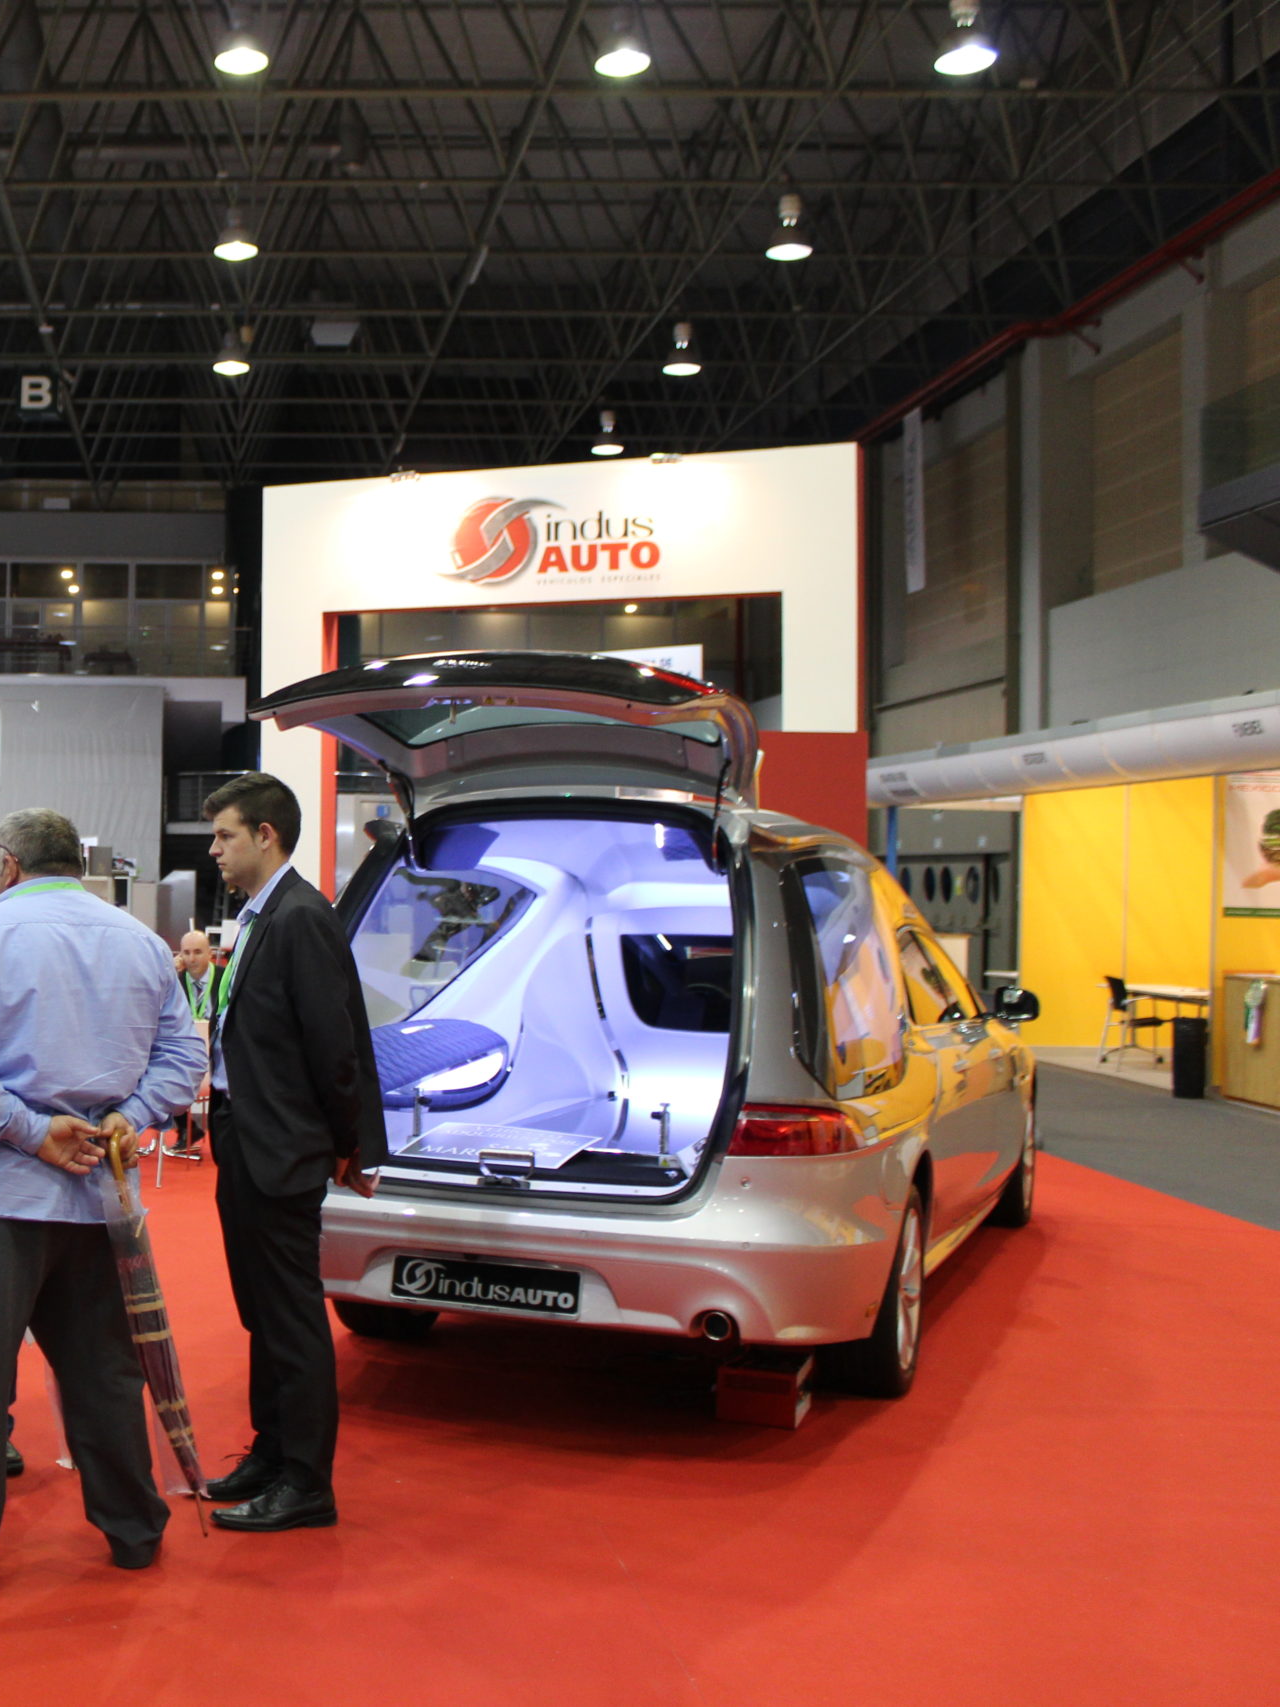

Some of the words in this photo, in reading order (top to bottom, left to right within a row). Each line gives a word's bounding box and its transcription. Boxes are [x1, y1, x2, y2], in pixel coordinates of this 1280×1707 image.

[21, 375, 52, 409] B
[545, 510, 654, 542] indus
[536, 541, 661, 574] AUTO
